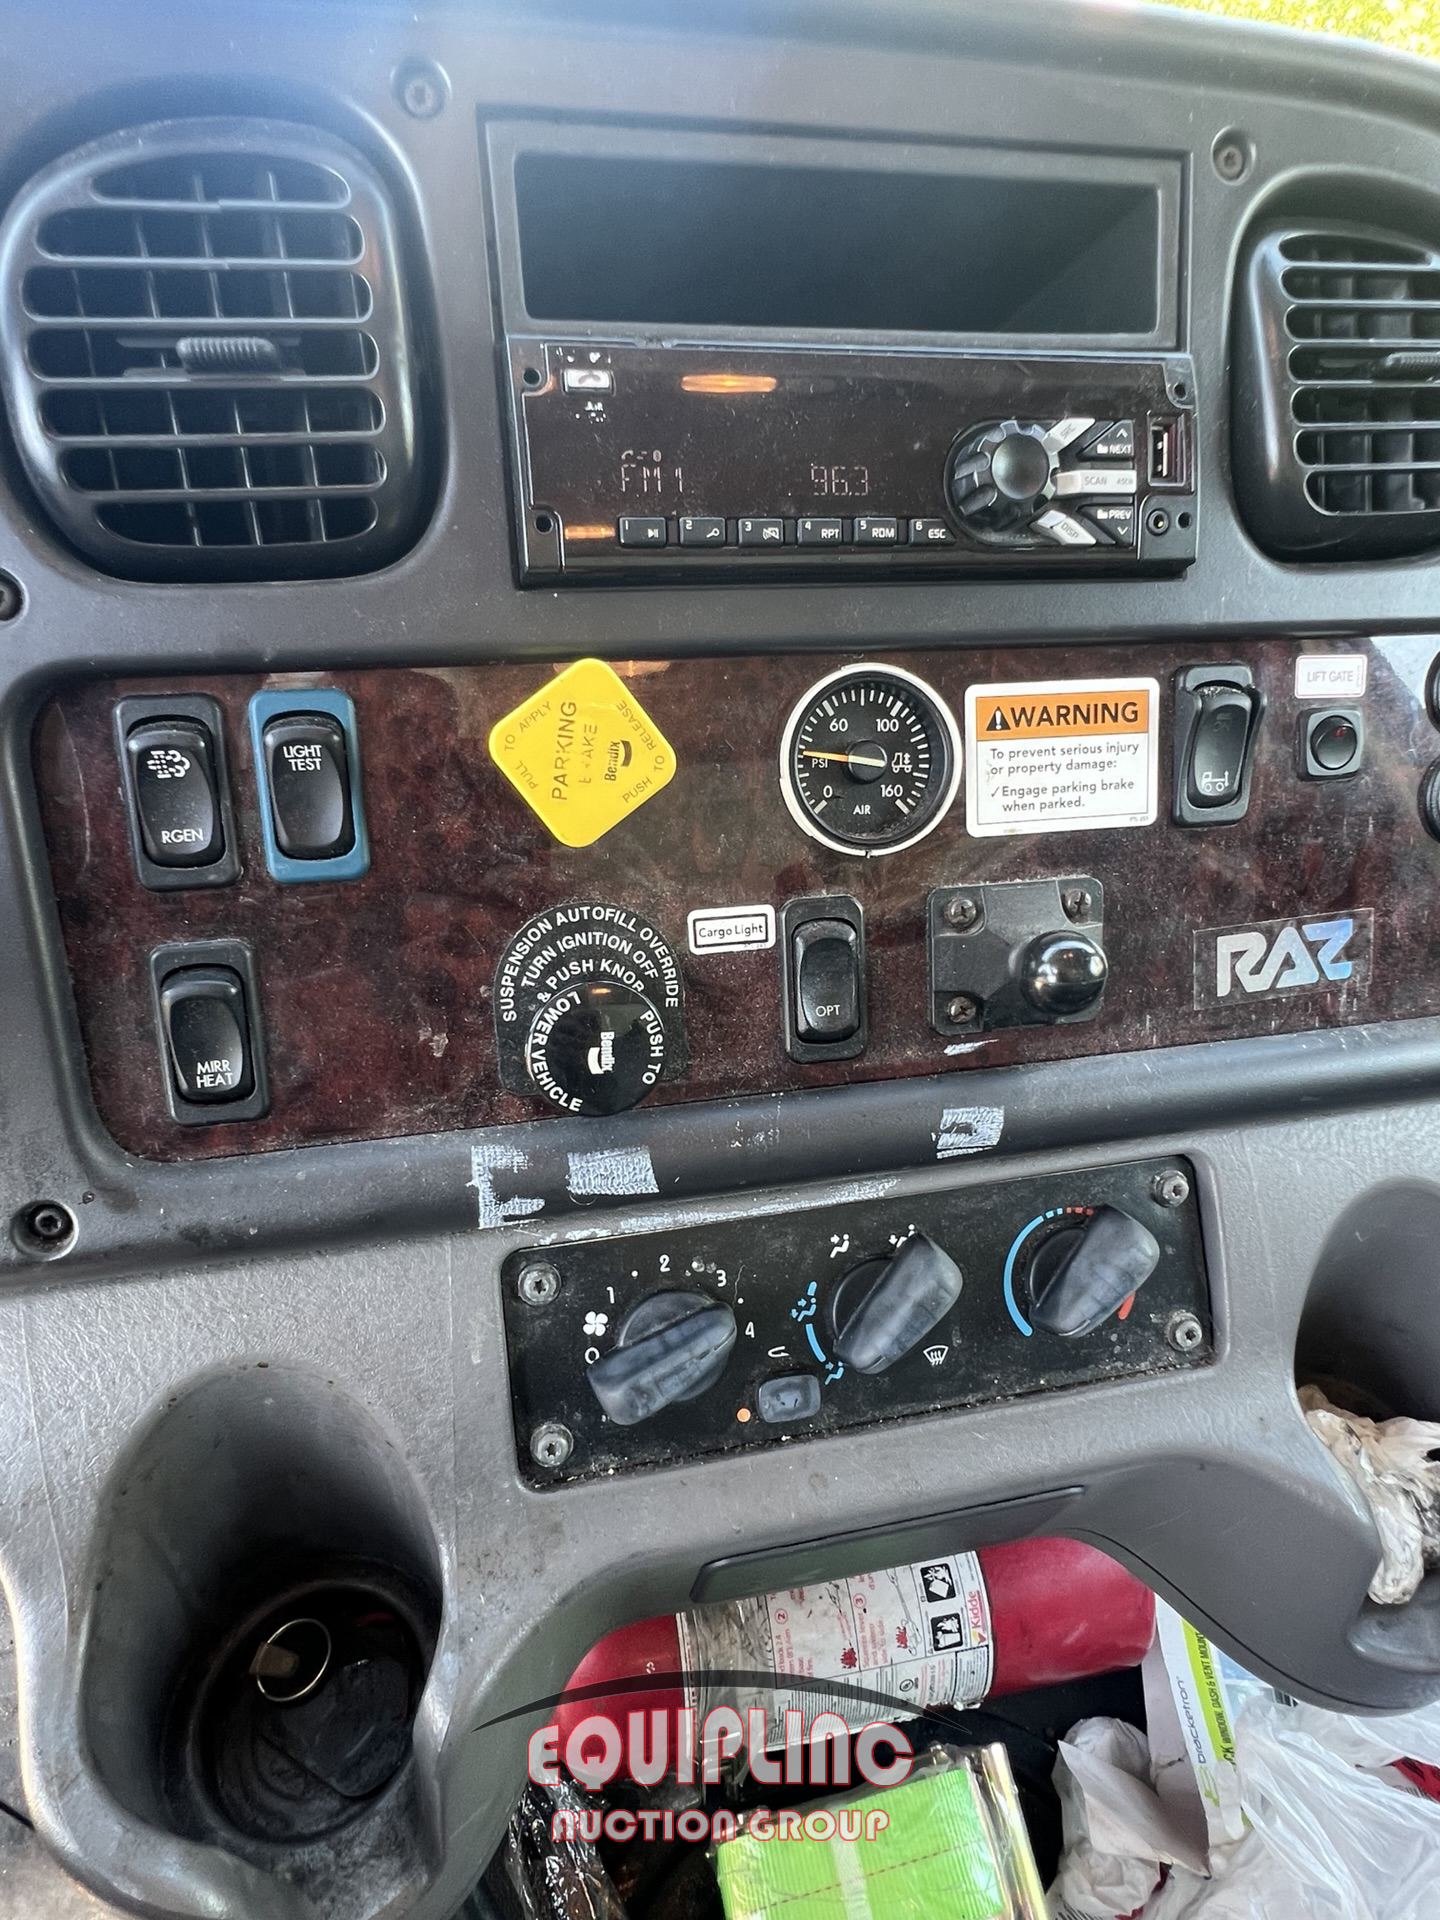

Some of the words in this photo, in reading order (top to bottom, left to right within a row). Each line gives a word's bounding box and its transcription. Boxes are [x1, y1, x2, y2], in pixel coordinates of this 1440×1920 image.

[1109, 444, 1132, 455] NEXT
[1084, 476, 1107, 486] SCAN
[1109, 510, 1132, 520] PREV
[685, 520, 693, 530] 2
[744, 521, 752, 531] 3
[804, 521, 812, 531] 4
[821, 528, 840, 540] RPT
[860, 520, 867, 530] 5
[916, 520, 923, 531] 6
[928, 528, 946, 540] ESC
[1060, 521, 1079, 540] DISP
[1306, 671, 1327, 683] LIFT
[1329, 670, 1354, 683] GATE
[518, 701, 552, 733] APPLY
[1010, 701, 1139, 728] WARNING
[616, 700, 657, 751] RELEASE
[829, 718, 849, 732] 60
[875, 718, 900, 732] 100
[282, 745, 322, 759] LIGHT
[504, 734, 516, 752] TO
[551, 701, 578, 801] PARKING
[990, 748, 1004, 760] To
[1009, 746, 1056, 761] prevent
[1060, 743, 1102, 756] serious
[1106, 741, 1140, 756] injury
[288, 758, 322, 771] TEST
[604, 740, 621, 782] Bendix
[654, 755, 666, 773] TO
[811, 758, 829, 769] PSI
[991, 766, 1004, 775] or
[1008, 761, 1062, 777] property
[1065, 759, 1118, 773] damage:
[515, 759, 539, 790] PULL
[622, 776, 653, 804] PUSH
[823, 785, 833, 798] 0
[880, 784, 903, 798] 160
[1002, 785, 1048, 799] Engage
[1052, 780, 1097, 797] parking
[1100, 778, 1134, 791] brake
[852, 804, 871, 815] AIR
[1002, 799, 1035, 812] when
[1039, 796, 1085, 812] parked.
[161, 828, 204, 844] RGEN
[698, 926, 733, 940] Cargo
[734, 924, 764, 937] Light
[500, 918, 553, 1022] SUSPENSION
[555, 906, 637, 932] AUTOFILL
[639, 927, 679, 1008] OVERRIDE
[520, 946, 557, 988] TURN
[557, 931, 632, 955] IGNITION
[632, 948, 658, 979] OFF
[1216, 918, 1353, 998] RAZ
[536, 992, 552, 1003] &
[545, 958, 594, 990] PUSH
[532, 990, 582, 1046] LOWER
[815, 1004, 841, 1017] OPT
[640, 1011, 664, 1057] PUSH
[600, 1031, 615, 1072] Bendix
[196, 1059, 231, 1075] MIRR
[641, 1063, 662, 1085] TO
[196, 1072, 233, 1089] HEAT
[530, 1049, 583, 1112] VEHICLE
[659, 1254, 671, 1273] 2
[716, 1269, 728, 1287] 3
[606, 1286, 615, 1304] 1
[745, 1321, 756, 1338] 4
[855, 1597, 864, 1605] 3
[966, 1590, 982, 1630] Kidde
[857, 1612, 866, 1634] lever
[859, 1635, 870, 1669] Squeeze
[871, 1651, 879, 1666] and
[880, 1647, 889, 1664] side
[1201, 1659, 1214, 1680] VENT
[1208, 1687, 1223, 1709] DASH
[1176, 1680, 1207, 1764] bracketron
[1214, 1710, 1232, 1744] WINDOW,
